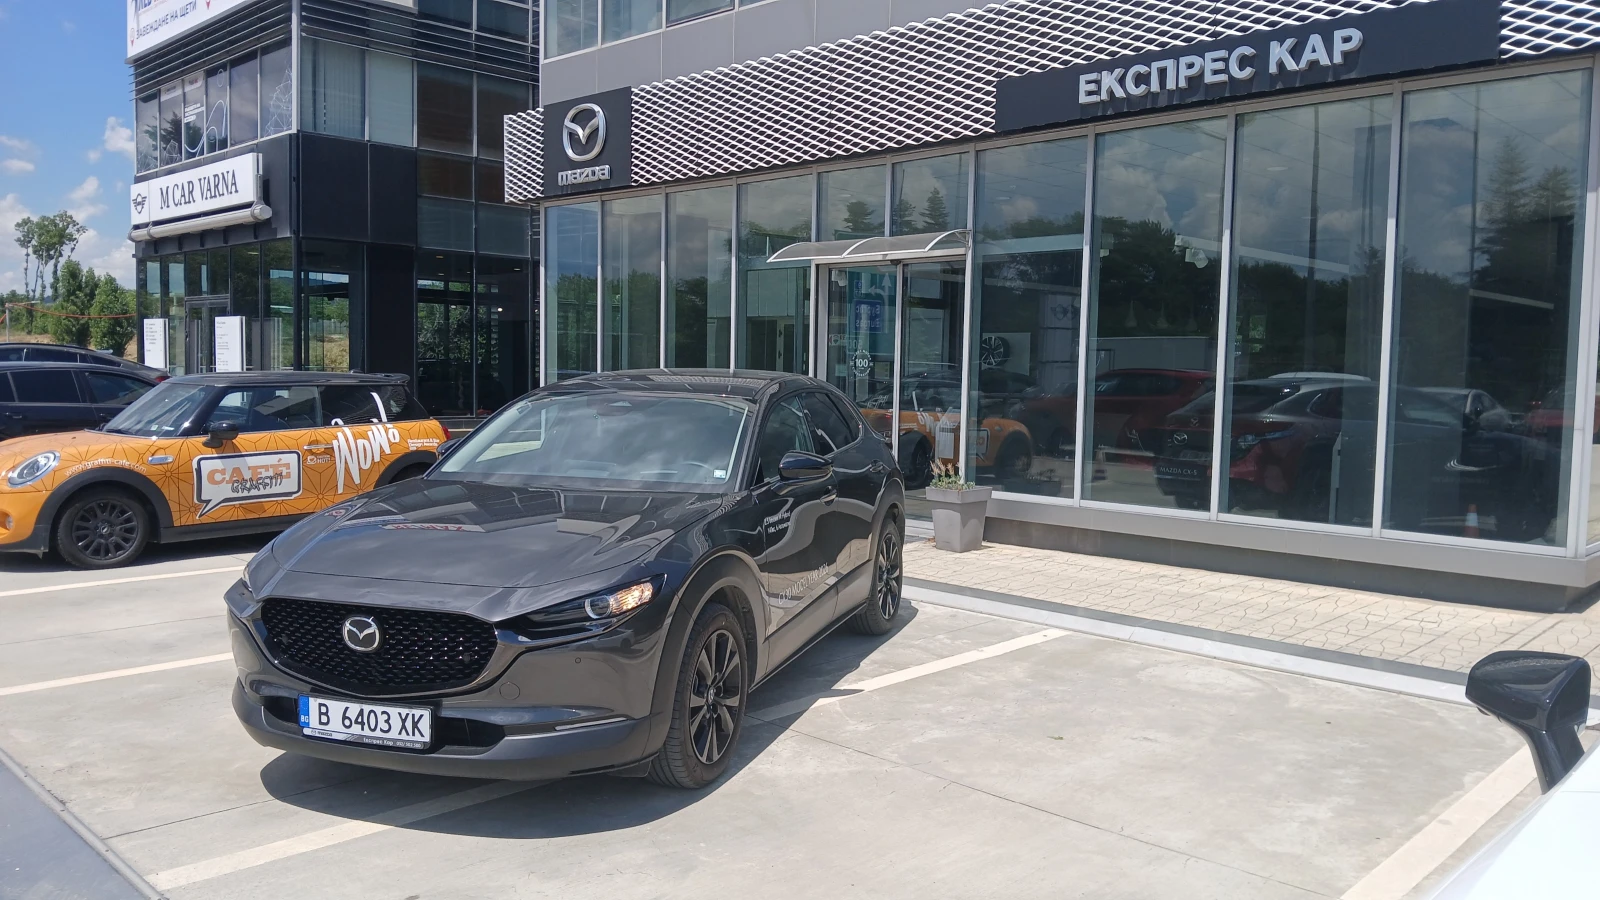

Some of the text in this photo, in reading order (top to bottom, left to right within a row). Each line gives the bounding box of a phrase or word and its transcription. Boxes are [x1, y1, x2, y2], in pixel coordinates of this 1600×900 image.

[136, 0, 197, 39] ЗАВЕЖДАНЕ НА ЩЕТИ
[1079, 28, 1363, 104] ЕКСПРЕС КАР
[160, 169, 239, 209] M CAR VARNA
[558, 165, 611, 186] mazda
[856, 359, 868, 367] 100
[64, 457, 147, 476] www.graffiti-cafe.com
[207, 458, 291, 486] CAFÉ
[300, 714, 309, 723] BG
[318, 702, 425, 738] B 6403 XK
